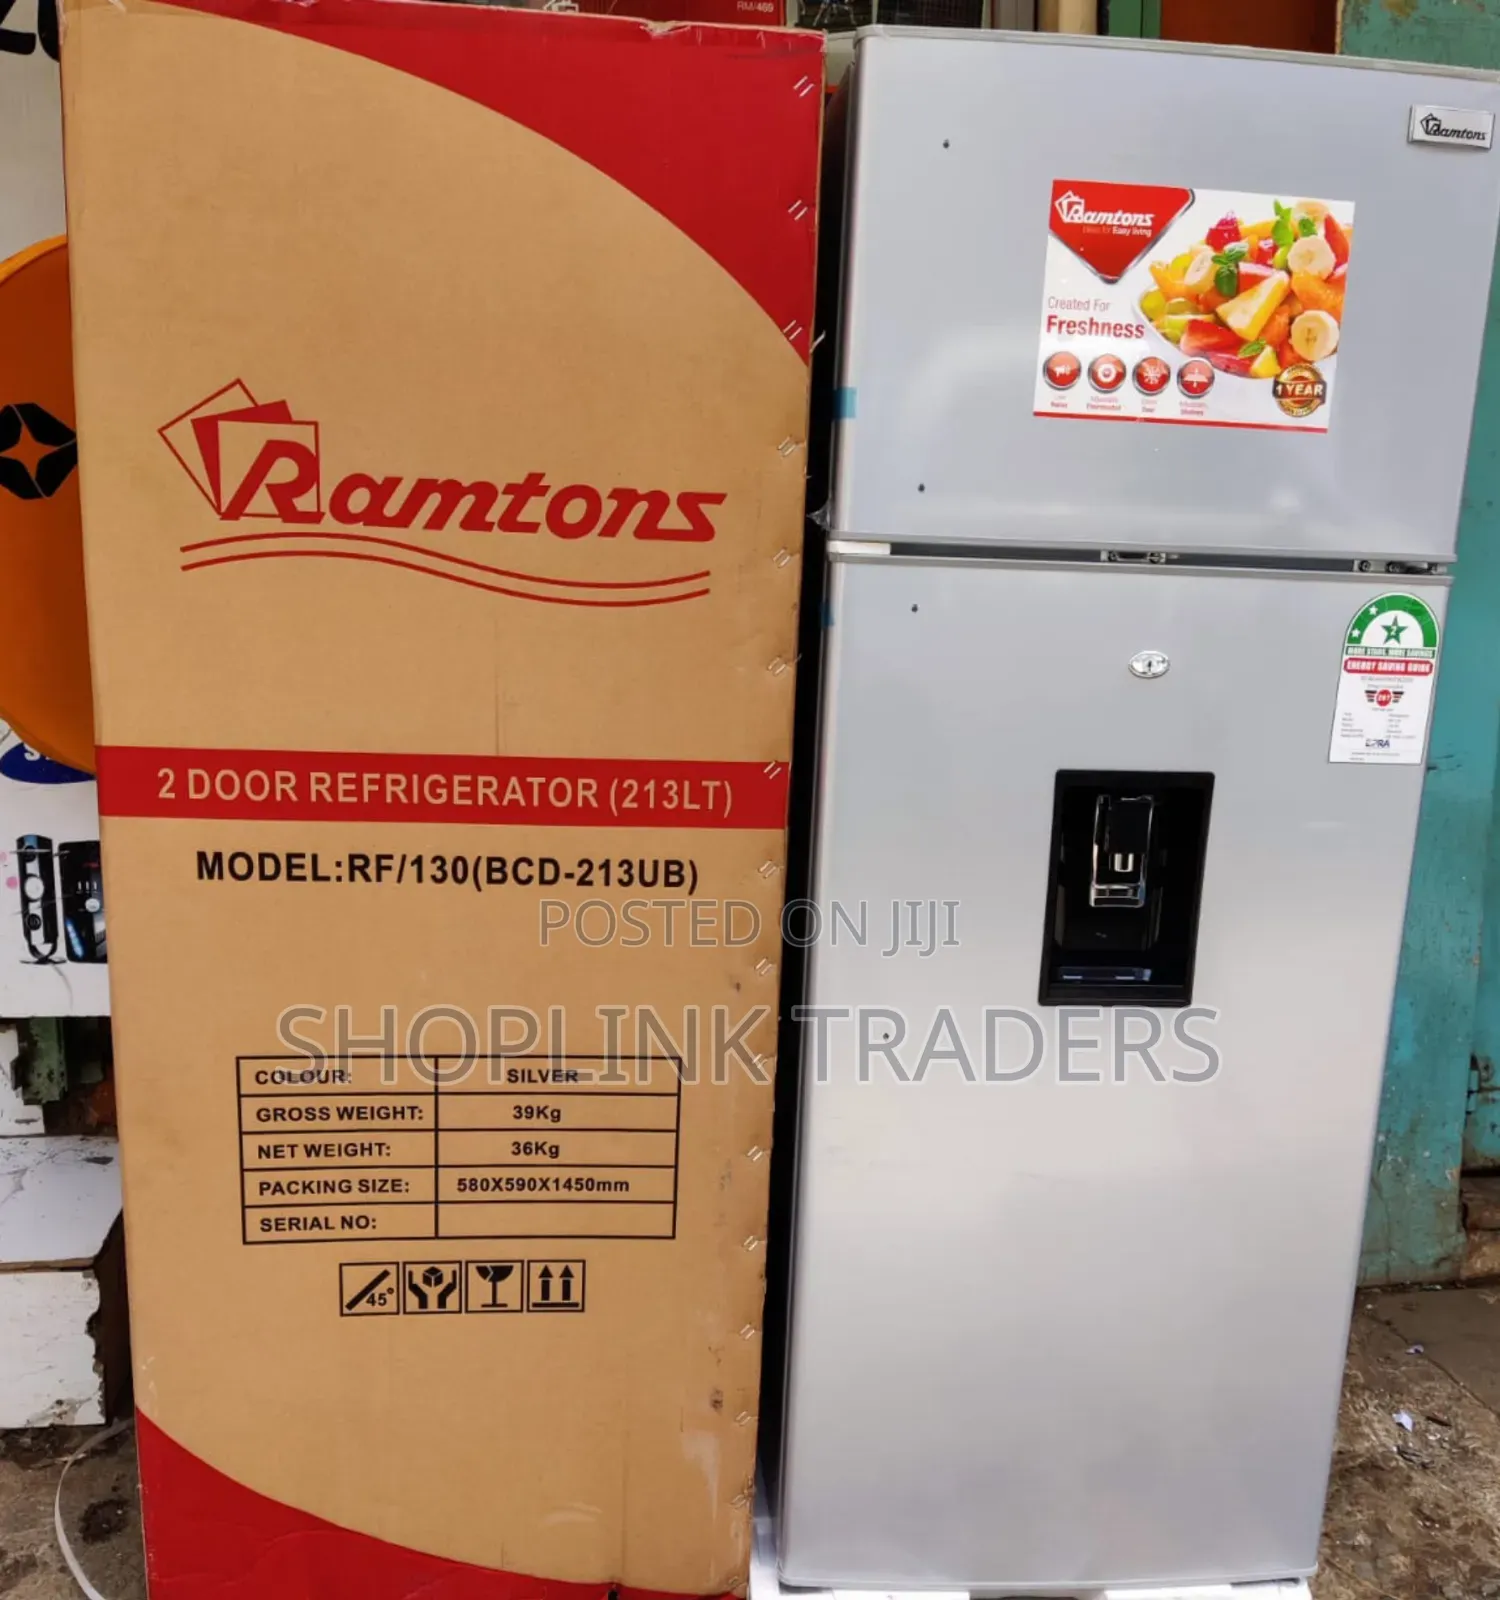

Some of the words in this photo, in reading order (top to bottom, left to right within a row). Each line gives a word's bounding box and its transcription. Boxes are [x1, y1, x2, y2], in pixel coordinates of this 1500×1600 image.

[736, 1, 774, 13] RM/469
[1425, 119, 1488, 140] Ramtons
[1064, 200, 1155, 226] Ramtons
[1047, 296, 1091, 311] Created
[1093, 299, 1111, 312] For
[1046, 315, 1145, 339] Freshness
[1276, 384, 1283, 396] 1
[1286, 384, 1323, 396] YEAR
[219, 440, 728, 543] Ramtons
[1347, 660, 1376, 671] ENERGY
[1377, 661, 1405, 672] SAVING
[157, 768, 176, 799] 2
[188, 768, 299, 802] DOOR
[309, 771, 599, 808] REFRIGERATOR
[609, 778, 732, 818] (213LT)
[196, 850, 698, 895] MODEL:RF/130(BCD-213UB)
[254, 1069, 352, 1085] COLOUR:
[507, 1068, 579, 1084] SILVER
[256, 1107, 331, 1122] GROSS
[336, 1106, 424, 1121] WEIGHT:
[512, 1105, 562, 1123] 39Kg
[257, 1144, 298, 1159] NET
[303, 1142, 391, 1158] WEIGHT:
[510, 1141, 560, 1159] 36Kg
[259, 1179, 352, 1196] PACKING
[357, 1178, 410, 1193] SIZE:
[457, 1177, 630, 1193] 580X590X1450mm
[260, 1217, 335, 1232] SERIAL
[340, 1215, 377, 1230] NO:
